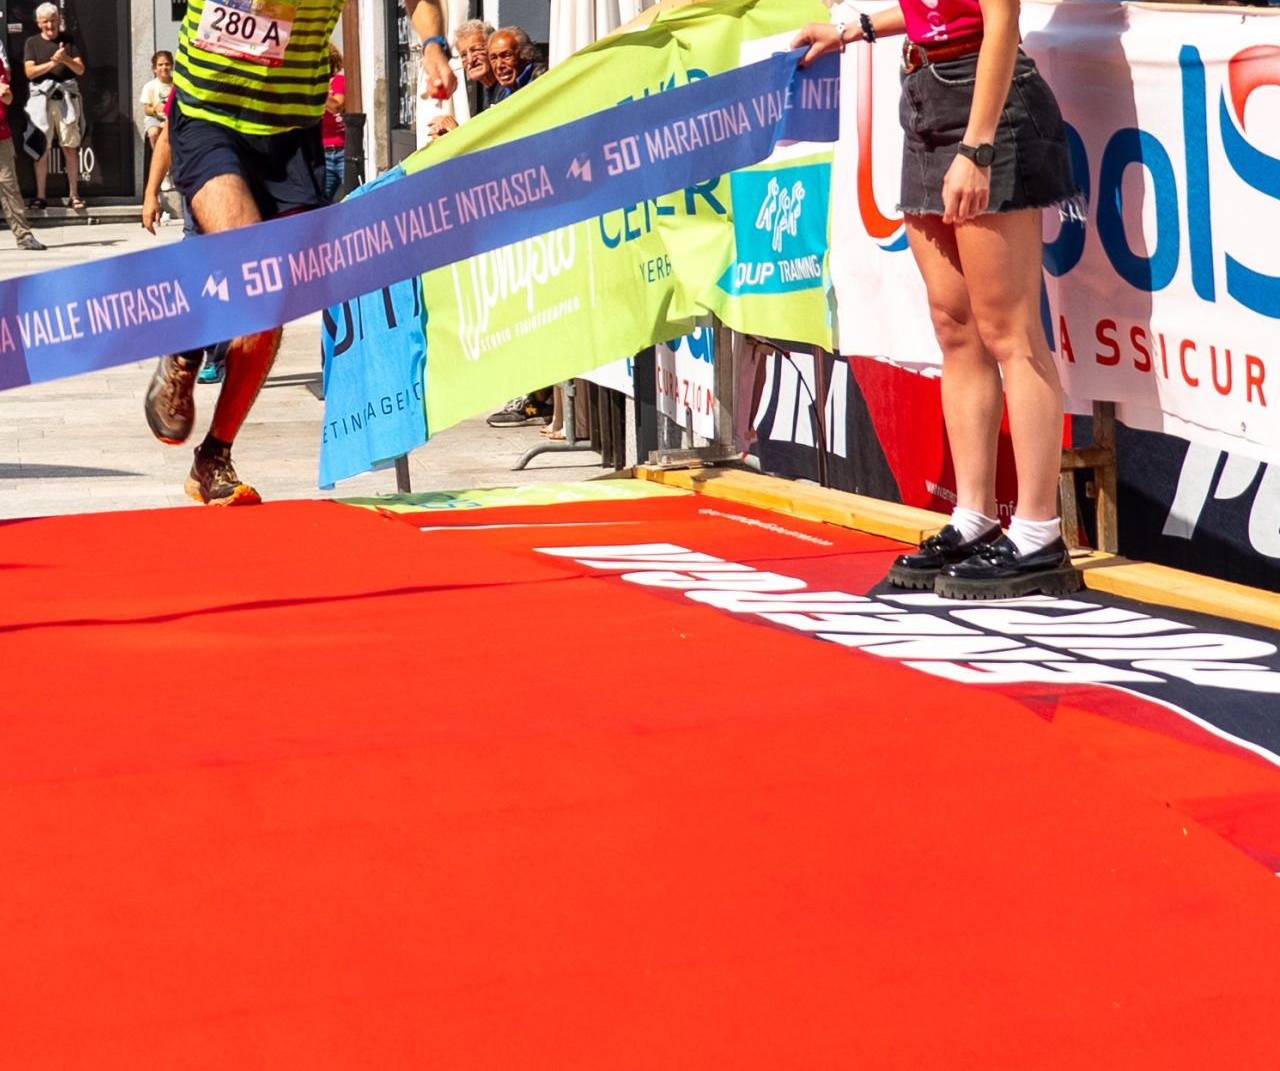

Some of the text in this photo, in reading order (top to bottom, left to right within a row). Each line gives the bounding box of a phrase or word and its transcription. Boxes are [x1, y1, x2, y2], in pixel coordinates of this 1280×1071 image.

[210, 6, 281, 47] 280 A
[644, 101, 752, 164] MARATONA
[287, 219, 394, 288] MARATONA
[394, 196, 453, 246] VALLE
[454, 164, 555, 226] INTRASCA
[16, 302, 84, 350] VALLE
[87, 278, 191, 335] INTRASCA
[481, 294, 580, 353] STUDIO FISIOTERAPICO
[531, 542, 1169, 685] ENERGIA
